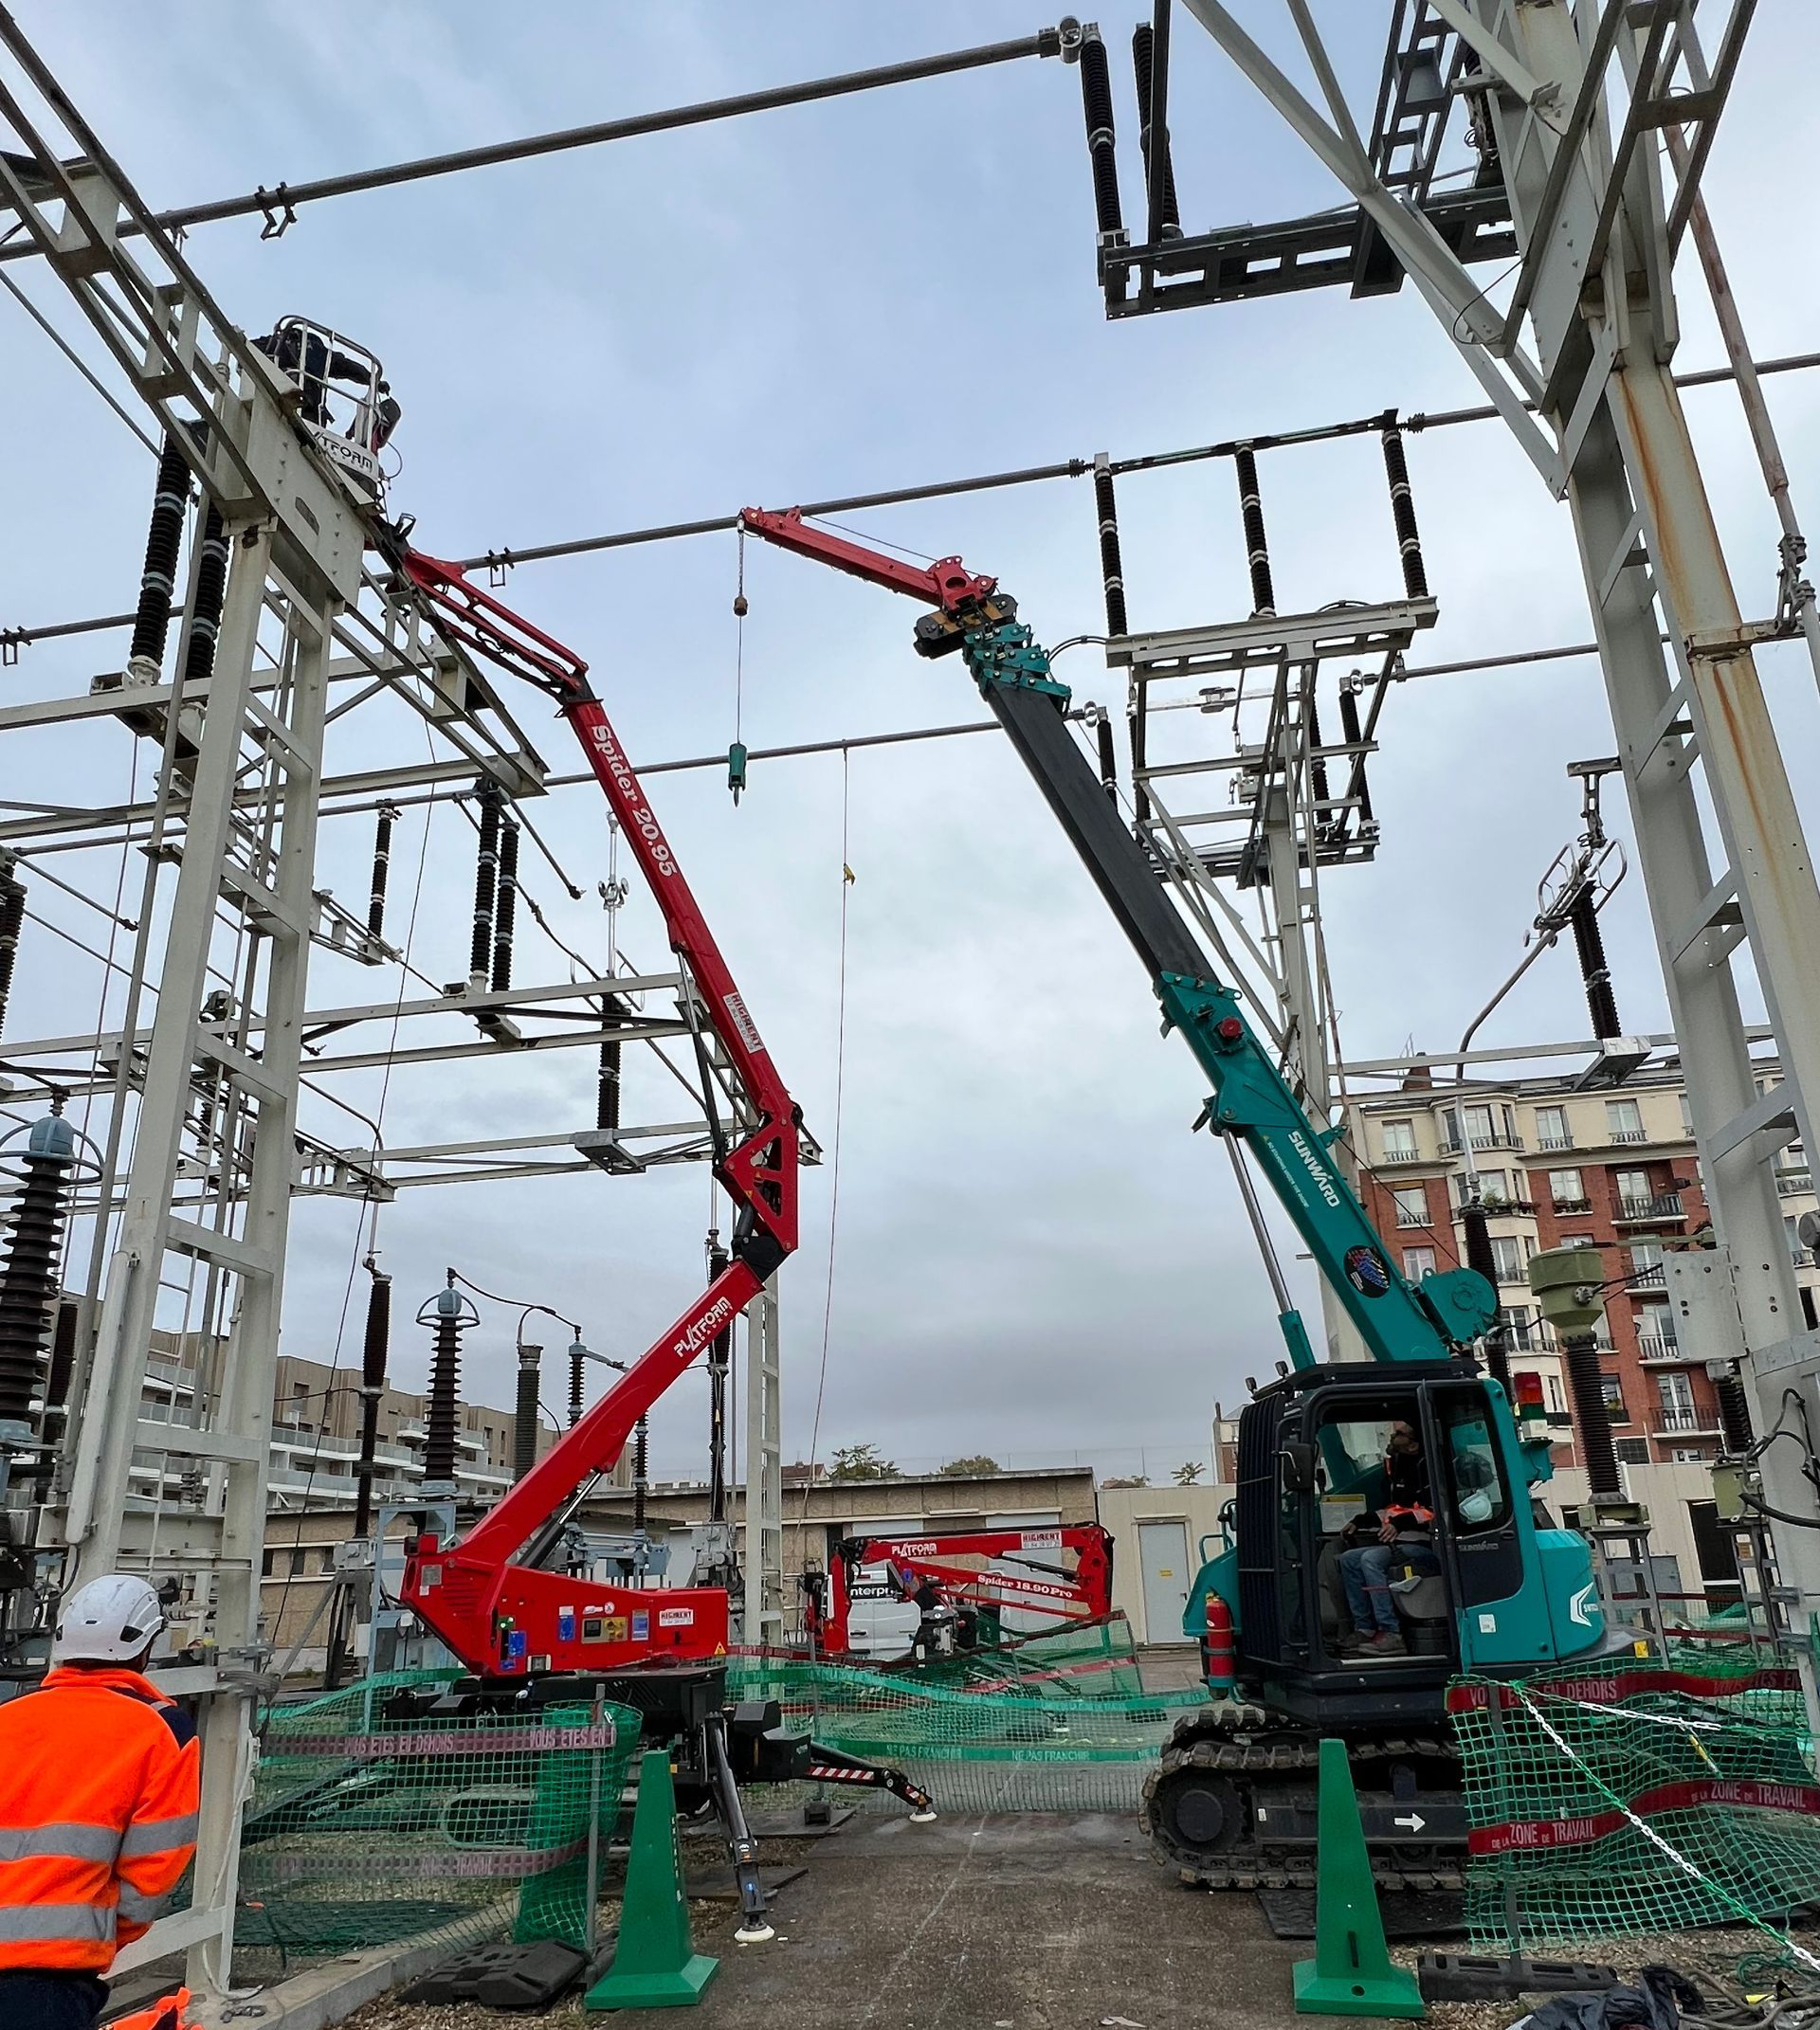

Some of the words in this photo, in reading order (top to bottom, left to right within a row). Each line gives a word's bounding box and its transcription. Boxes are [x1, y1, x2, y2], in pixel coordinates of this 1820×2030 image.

[592, 725, 638, 802] Spider
[632, 807, 677, 877] 20.95
[1288, 1131, 1340, 1207] SUNWARD
[673, 1296, 733, 1357] PLATFORM
[892, 1542, 937, 1557] PLATFORM
[977, 1574, 1014, 1588] Spider
[1566, 1680, 1617, 1702] DEHORS
[530, 1729, 555, 1748] VOUS
[1711, 1781, 1741, 1801] ZONE
[1757, 1784, 1806, 1808] TRAVAIL
[1492, 1839, 1501, 1849] DE
[1502, 1837, 1510, 1846] LA
[1510, 1823, 1538, 1844] ZONE
[1541, 1834, 1550, 1843] DE
[1552, 1820, 1595, 1842] TRAVAIL
